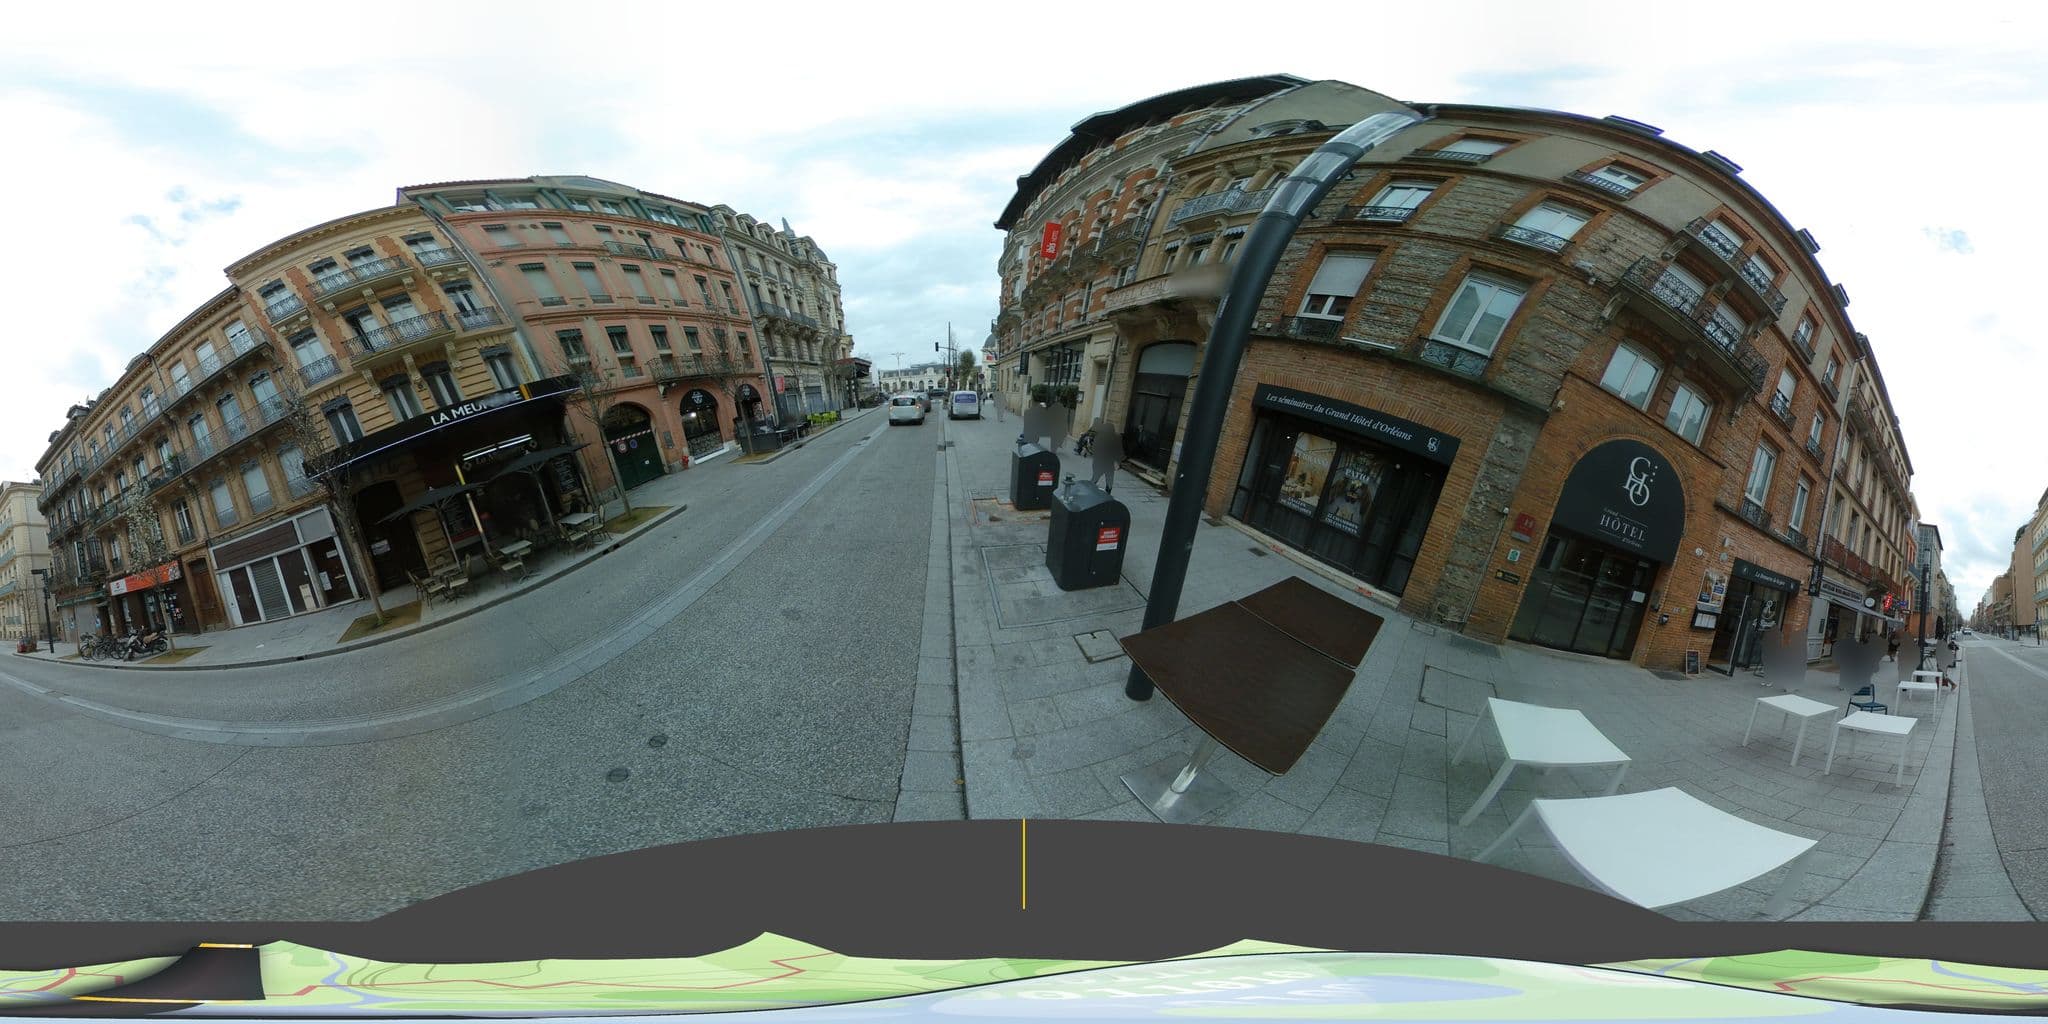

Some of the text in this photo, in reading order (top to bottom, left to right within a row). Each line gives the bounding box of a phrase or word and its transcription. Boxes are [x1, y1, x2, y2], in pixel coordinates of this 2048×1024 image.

[430, 412, 450, 426] LA
[1266, 392, 1413, 441] Les séminaires du Grand Hôtel d'Orléans
[1600, 515, 1645, 542] HÔTEL
